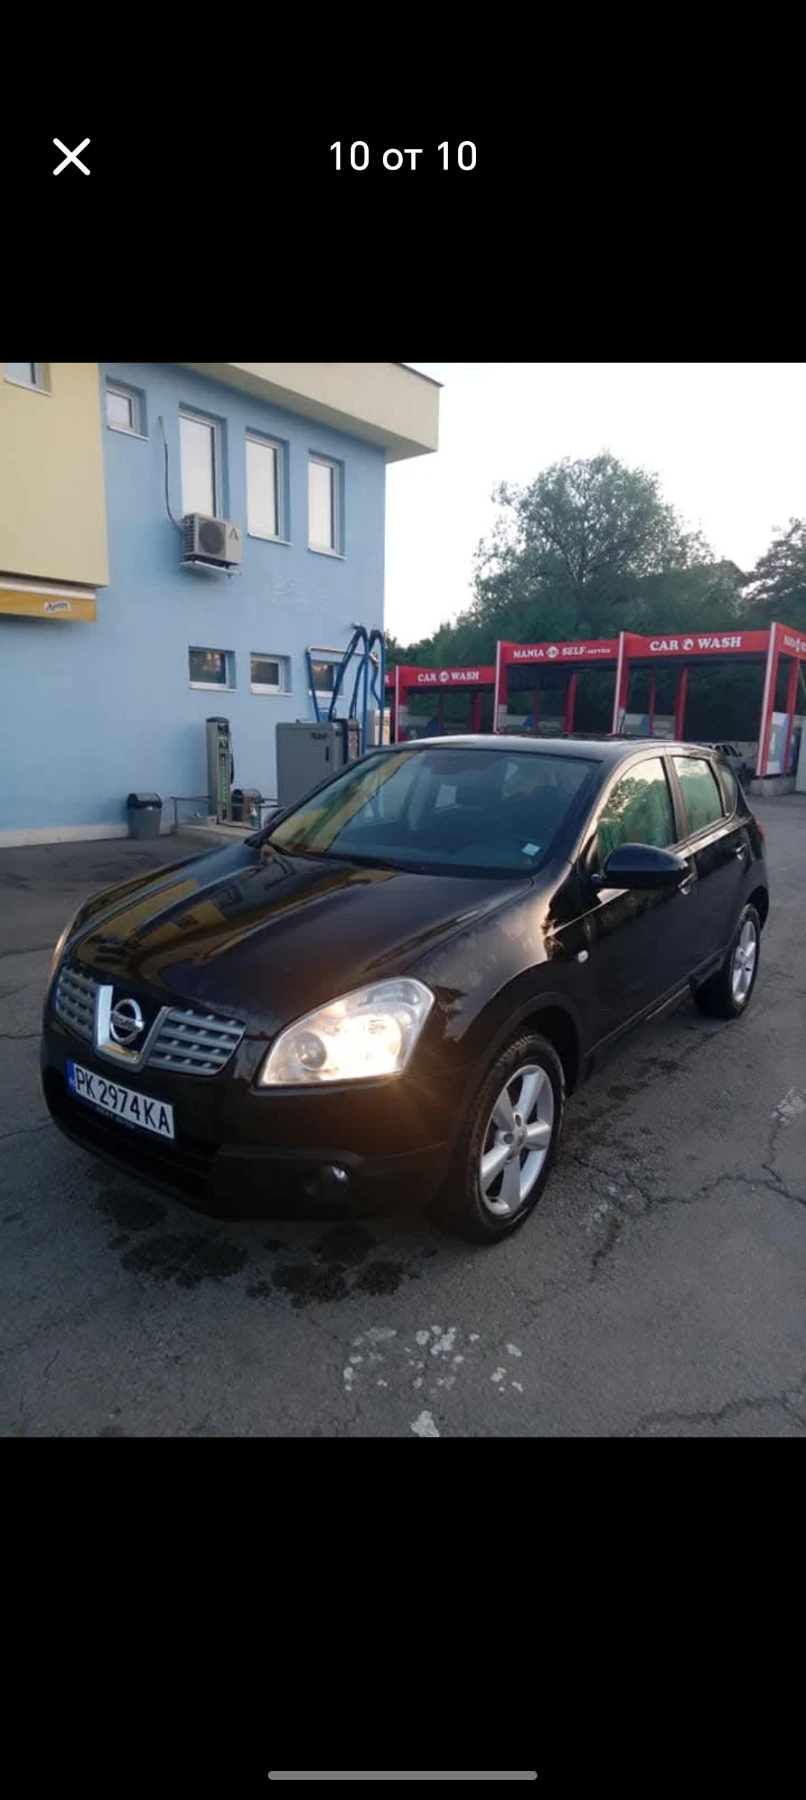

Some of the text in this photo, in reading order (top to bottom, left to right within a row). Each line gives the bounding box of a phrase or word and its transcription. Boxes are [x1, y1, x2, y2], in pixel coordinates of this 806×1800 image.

[650, 636, 742, 651] CAR WASH
[513, 649, 545, 659] MANIA
[417, 671, 480, 682] CAR WASH
